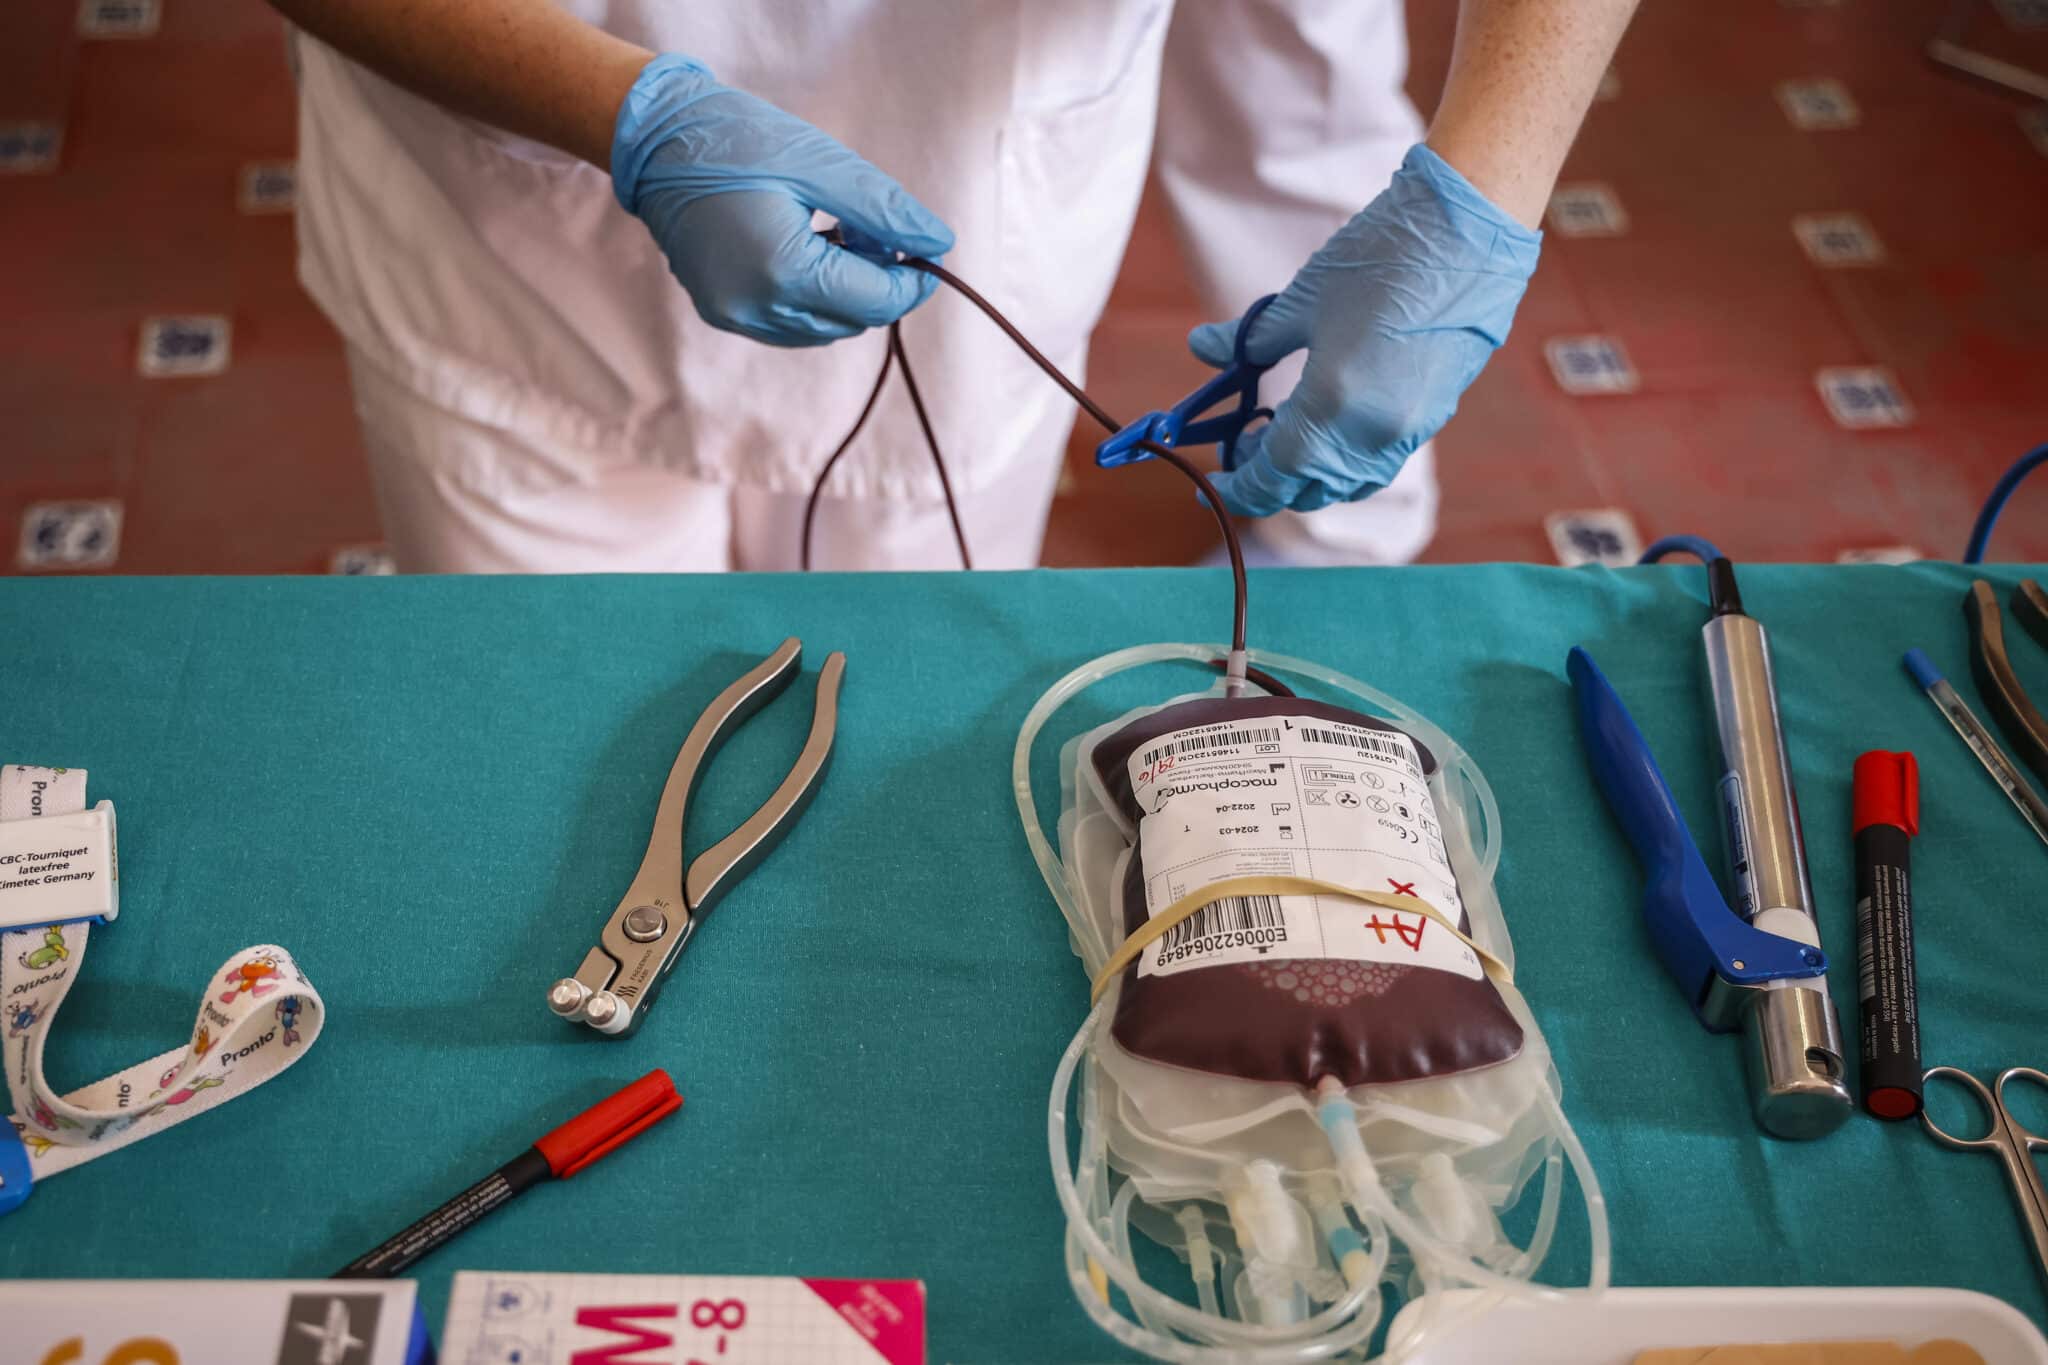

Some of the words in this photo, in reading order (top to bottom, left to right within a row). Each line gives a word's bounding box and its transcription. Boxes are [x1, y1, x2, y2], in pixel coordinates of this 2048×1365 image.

[31, 781, 47, 816] Pron
[1216, 803, 1256, 813] 2022-04
[1219, 825, 1260, 835] 2024-03
[0, 847, 88, 865] CBC-Tourniquet
[18, 862, 70, 875] latexfree
[43, 871, 95, 884] Germany
[1363, 913, 1427, 952] A+
[1157, 927, 1288, 967] E000622064849
